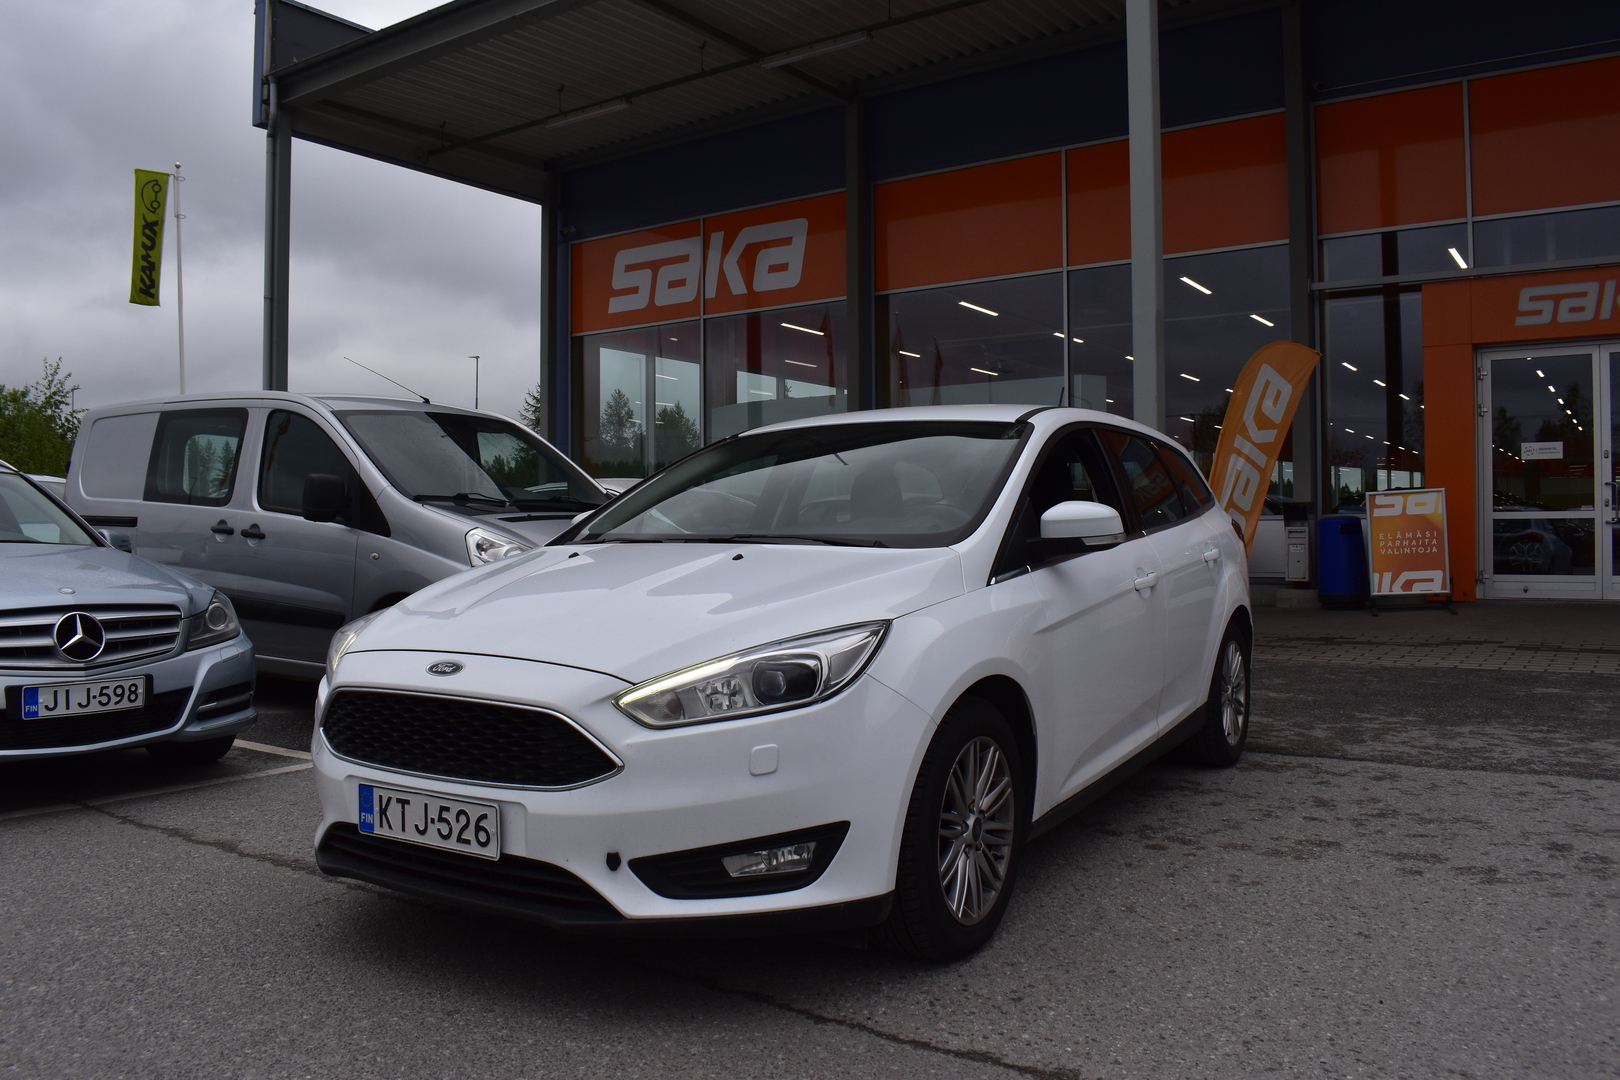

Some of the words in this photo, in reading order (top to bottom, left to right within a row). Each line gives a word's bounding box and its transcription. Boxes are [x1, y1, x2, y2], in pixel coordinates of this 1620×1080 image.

[139, 213, 159, 299] KAMUX
[1379, 530, 1437, 539] ELÄMÄSI
[1380, 538, 1438, 547] PARHAITA
[1380, 546, 1438, 554] VALINTOJA
[432, 662, 457, 673] Ford
[44, 682, 139, 712] JIJ-598
[25, 704, 38, 713] FIN
[361, 812, 374, 824] FIN
[378, 794, 491, 848] KTJ-526
